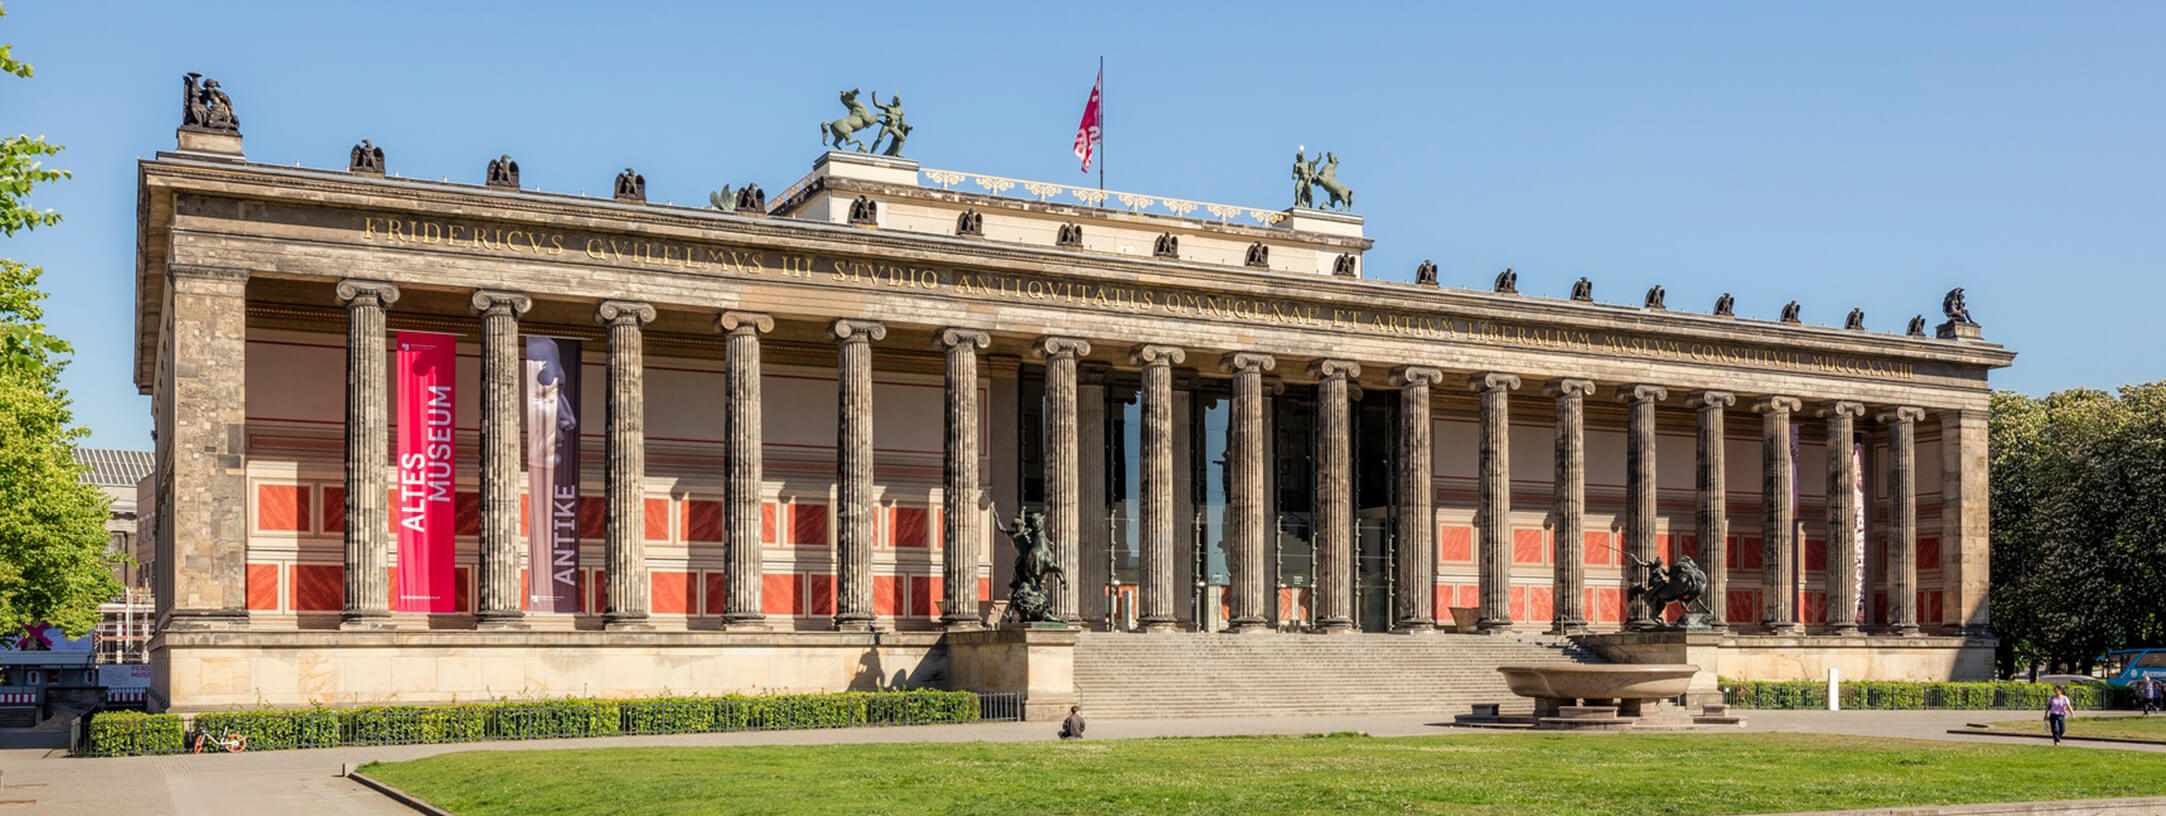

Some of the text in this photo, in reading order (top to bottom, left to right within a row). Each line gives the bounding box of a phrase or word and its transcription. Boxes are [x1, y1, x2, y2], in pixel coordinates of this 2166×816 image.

[363, 216, 1913, 379] FRIDERICVS GVILELMVS III STVDIO ANTIQVITATIS OMNIGENAE ET ARTIVM LIBERALIVM MVSEVM CONSTITVIT MDCCCXXVIII
[401, 453, 425, 533] ALTES
[427, 385, 452, 502] MUSEUM
[553, 484, 576, 586] ANTIKE
